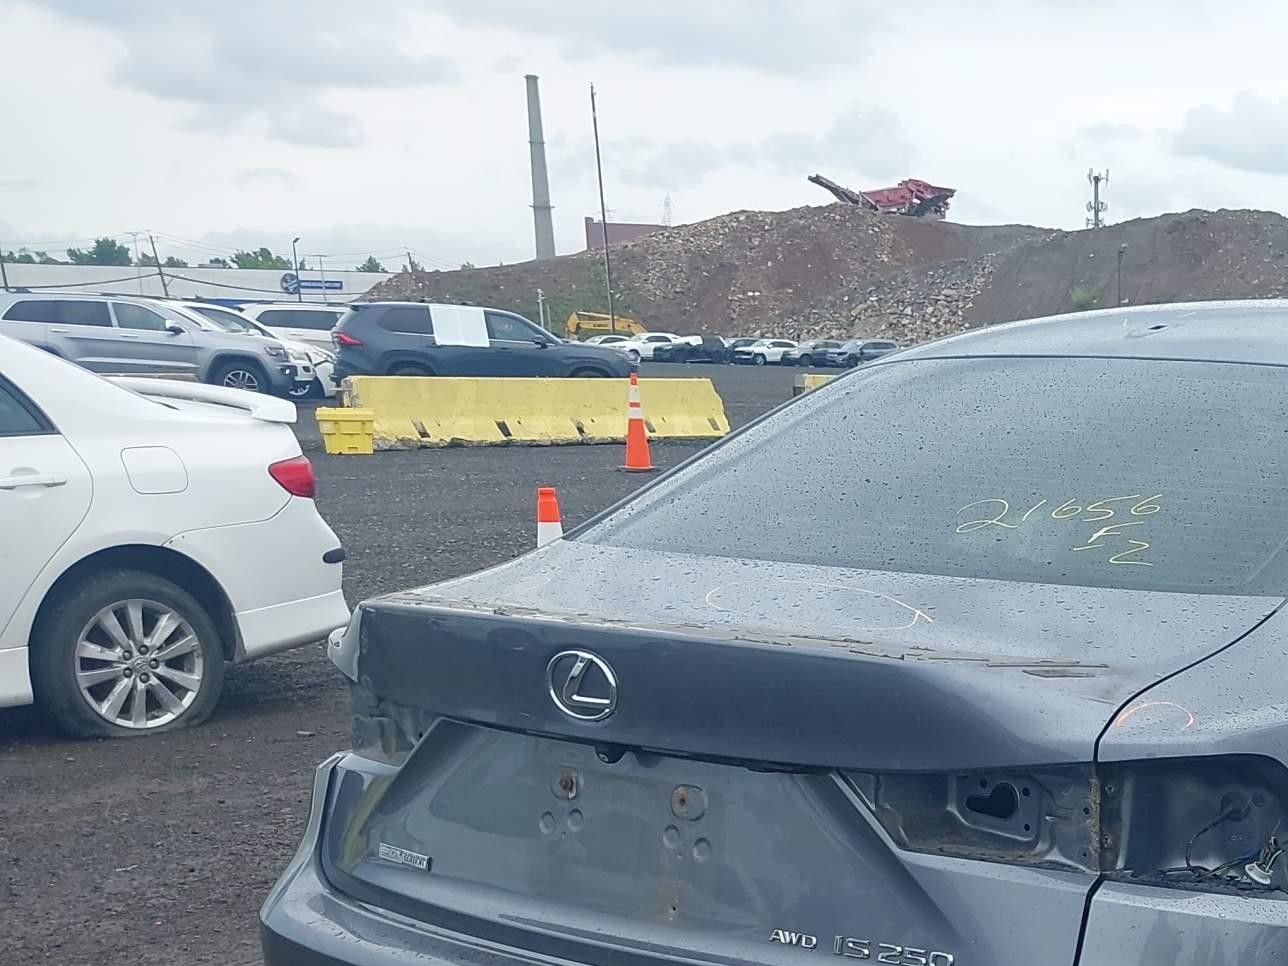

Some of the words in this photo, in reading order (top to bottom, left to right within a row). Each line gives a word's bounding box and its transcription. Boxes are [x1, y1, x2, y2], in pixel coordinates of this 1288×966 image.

[956, 494, 1163, 533] 21656
[769, 928, 818, 949] AWD
[833, 935, 872, 960] IS
